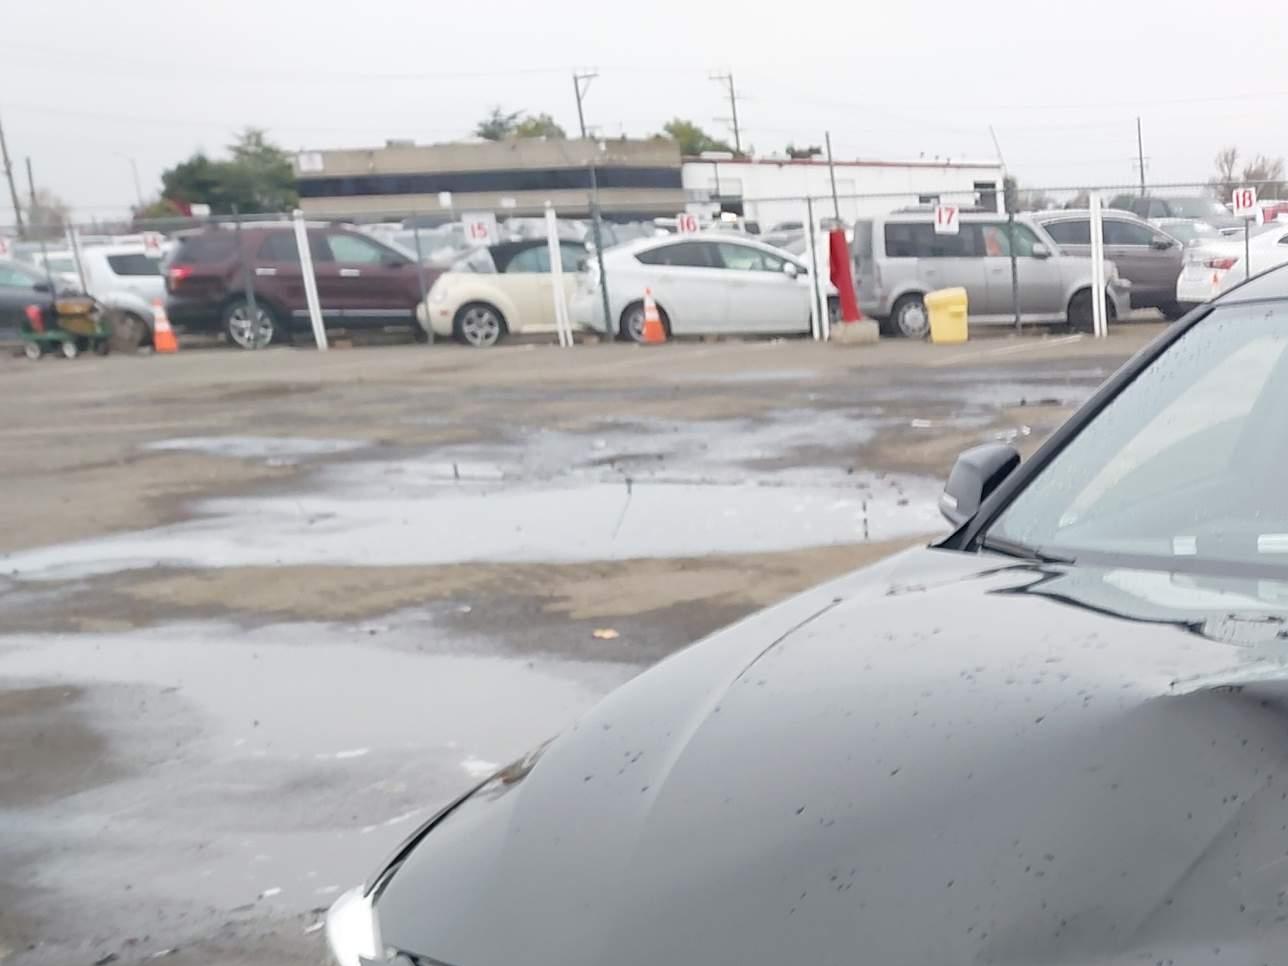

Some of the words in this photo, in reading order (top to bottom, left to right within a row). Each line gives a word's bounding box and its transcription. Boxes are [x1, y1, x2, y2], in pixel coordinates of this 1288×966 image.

[1235, 190, 1253, 209] 18
[679, 214, 697, 233] 16
[937, 207, 955, 225] 17
[470, 222, 487, 239] 15
